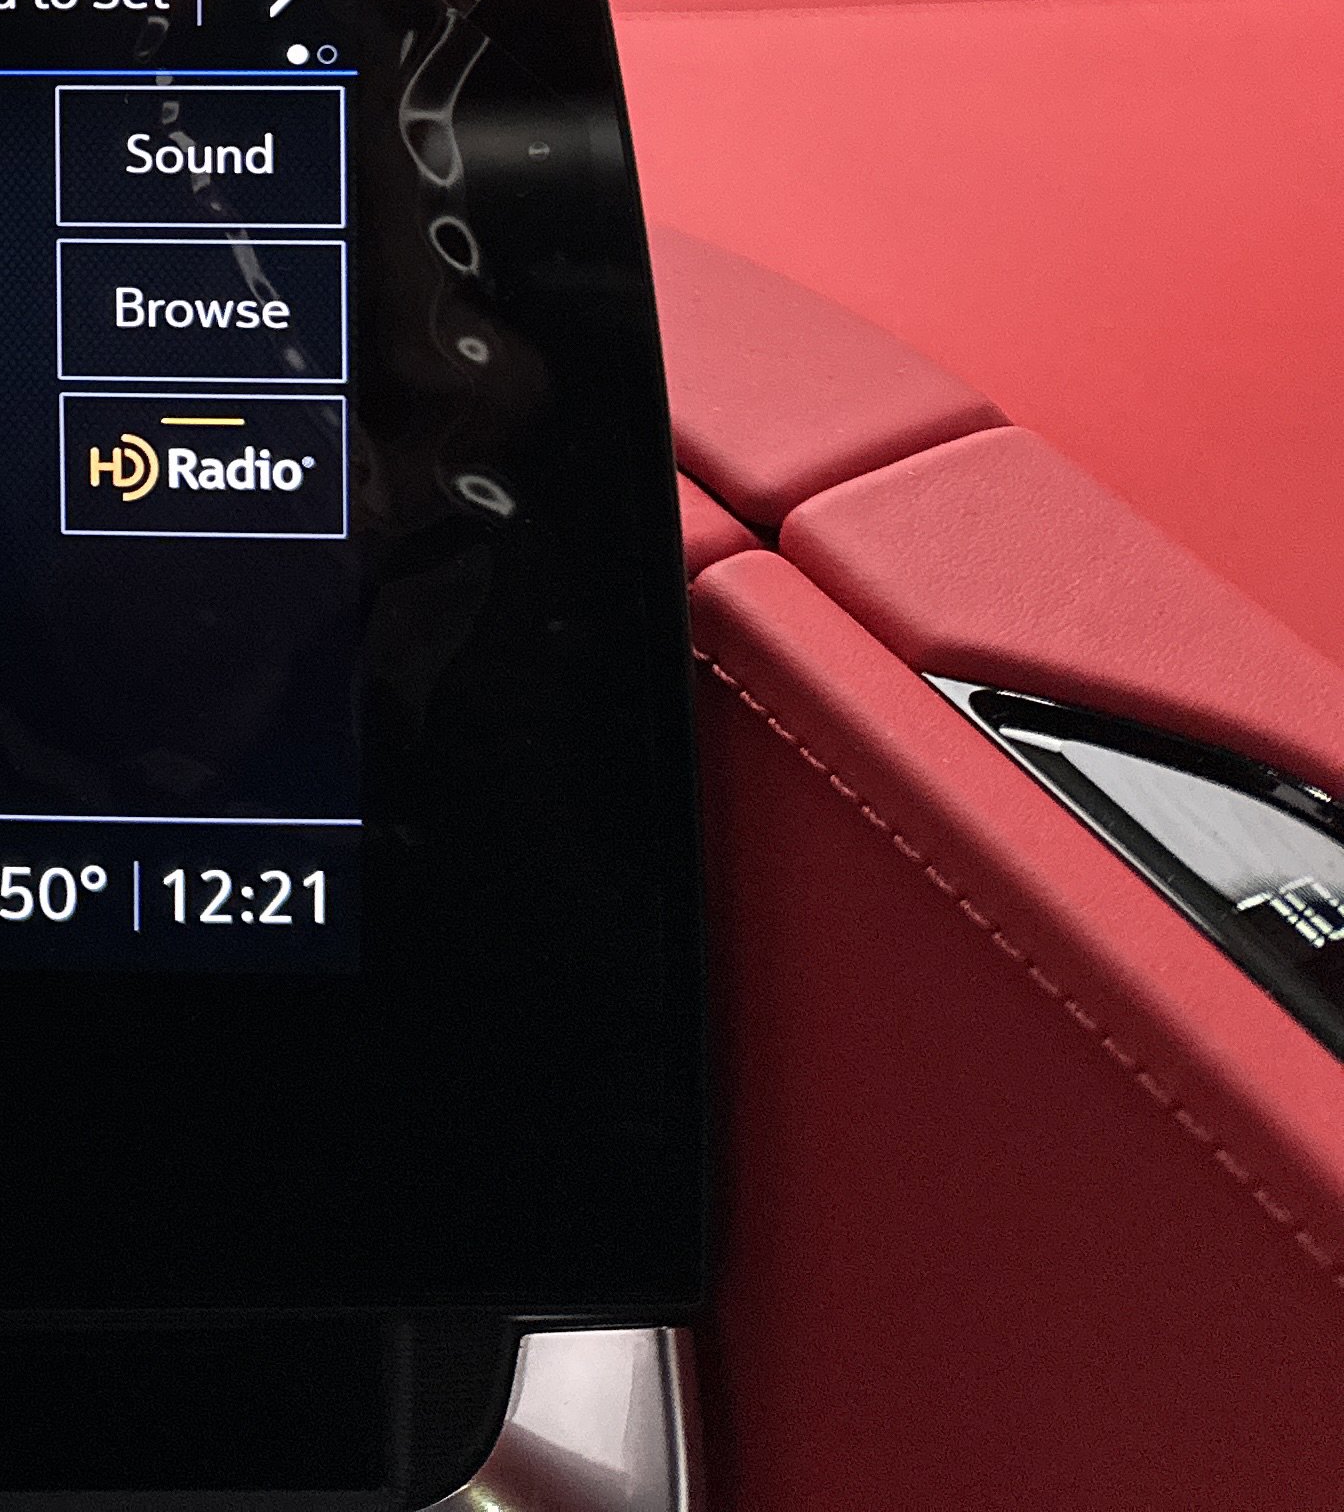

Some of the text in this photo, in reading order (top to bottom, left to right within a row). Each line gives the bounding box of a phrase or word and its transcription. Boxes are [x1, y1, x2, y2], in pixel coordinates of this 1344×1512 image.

[125, 133, 274, 175] Sound
[115, 286, 291, 329] Browse
[89, 433, 160, 502] HD
[0, 864, 108, 922] 50°
[163, 868, 327, 925] 12:21
